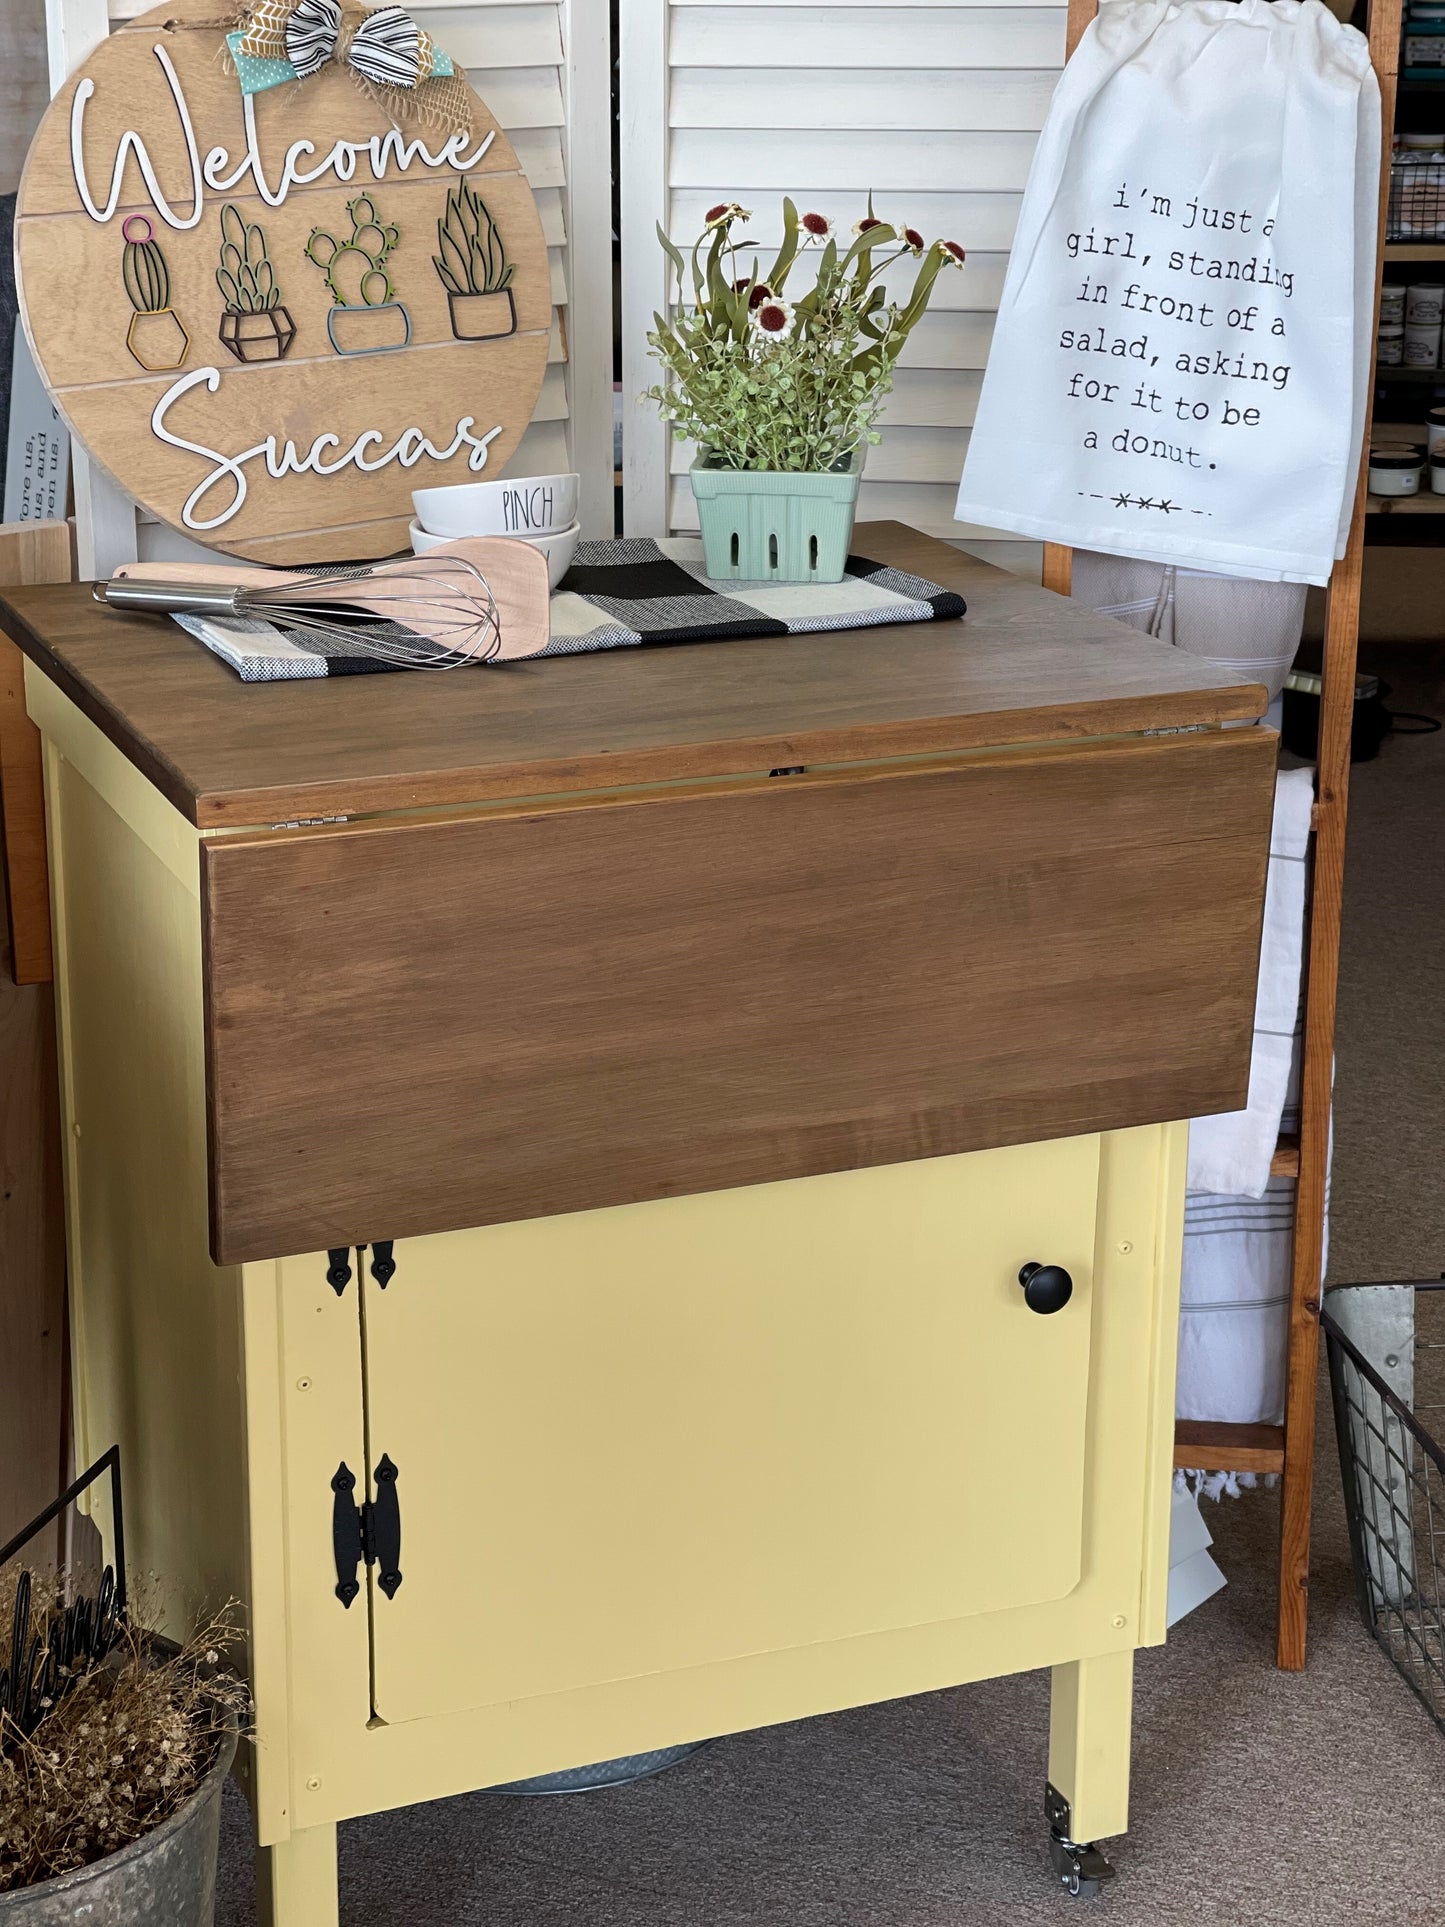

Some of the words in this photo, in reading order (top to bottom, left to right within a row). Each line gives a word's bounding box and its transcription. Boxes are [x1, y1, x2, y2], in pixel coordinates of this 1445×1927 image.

[71, 43, 497, 231] Welcome
[1112, 183, 1172, 217] i'm
[1182, 196, 1253, 233] just
[1262, 218, 1276, 237] a
[1066, 227, 1152, 267] girl,
[1076, 275, 1108, 304] in
[1120, 283, 1214, 327] front
[1226, 306, 1259, 331] of
[1270, 317, 1287, 337] a
[1059, 328, 1160, 368] salad,
[1174, 351, 1292, 391] asking
[1066, 373, 1120, 403] for
[1130, 382, 1163, 413] it
[1174, 397, 1210, 421] to
[1220, 400, 1261, 426] be
[24, 435, 37, 468] us,
[37, 432, 47, 479] and
[151, 367, 503, 531] Succas
[1083, 431, 1099, 450] a
[1111, 429, 1217, 470] donut.
[502, 487, 553, 531] PINCH
